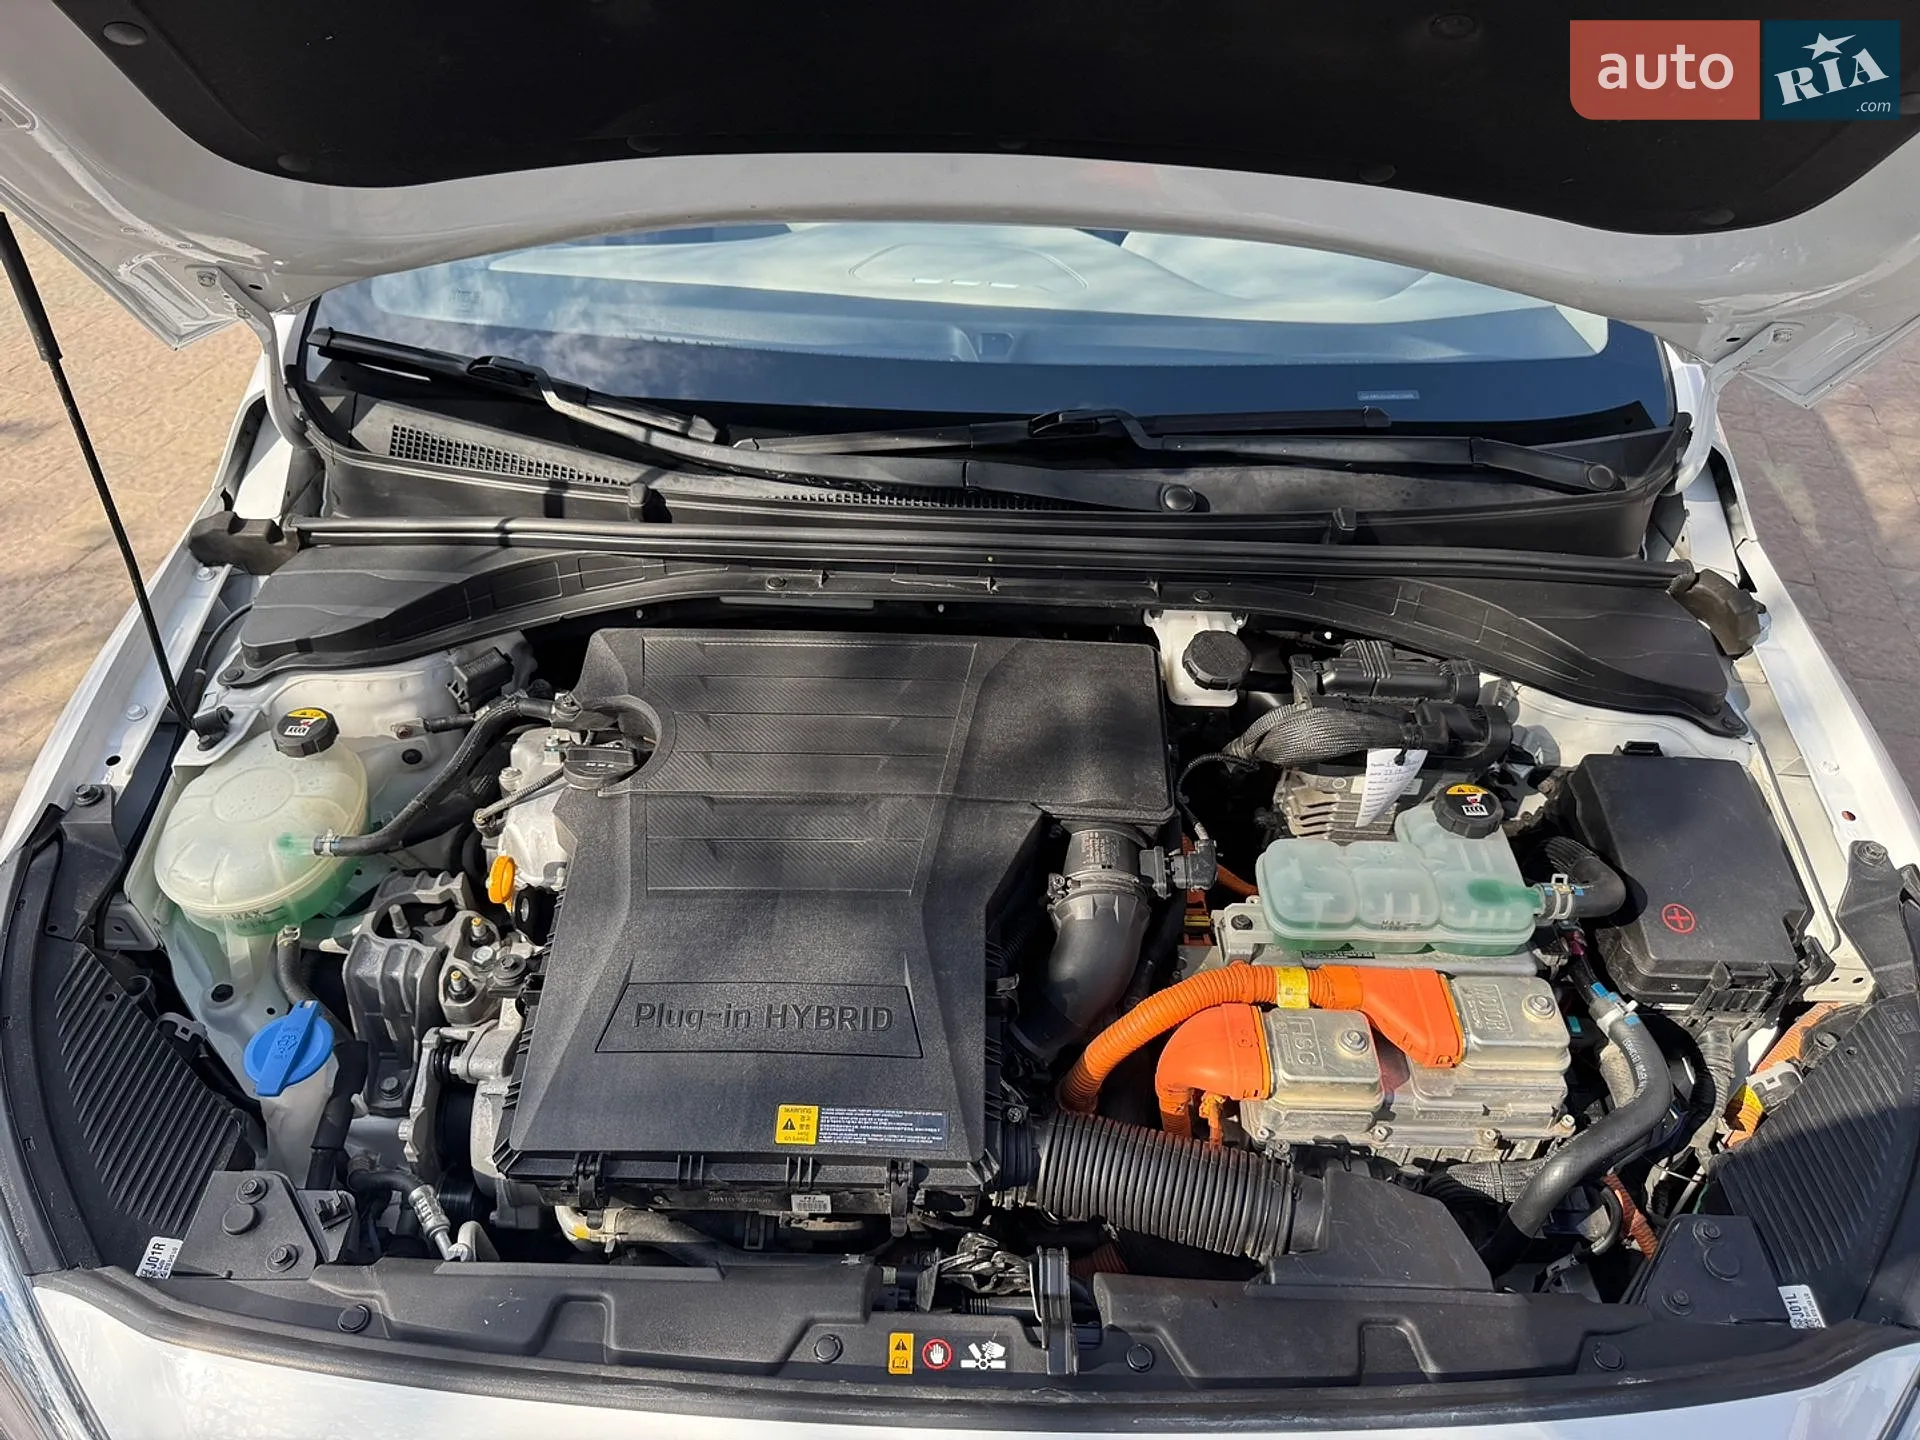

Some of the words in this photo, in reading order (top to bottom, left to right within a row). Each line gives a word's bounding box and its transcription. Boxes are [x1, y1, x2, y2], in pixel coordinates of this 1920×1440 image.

[633, 1002, 752, 1031] Plug-in
[764, 1003, 894, 1033] HYBRID
[1289, 1021, 1317, 1066] HSG
[145, 1242, 166, 1269] J01R
[1784, 1293, 1805, 1319] J01L
